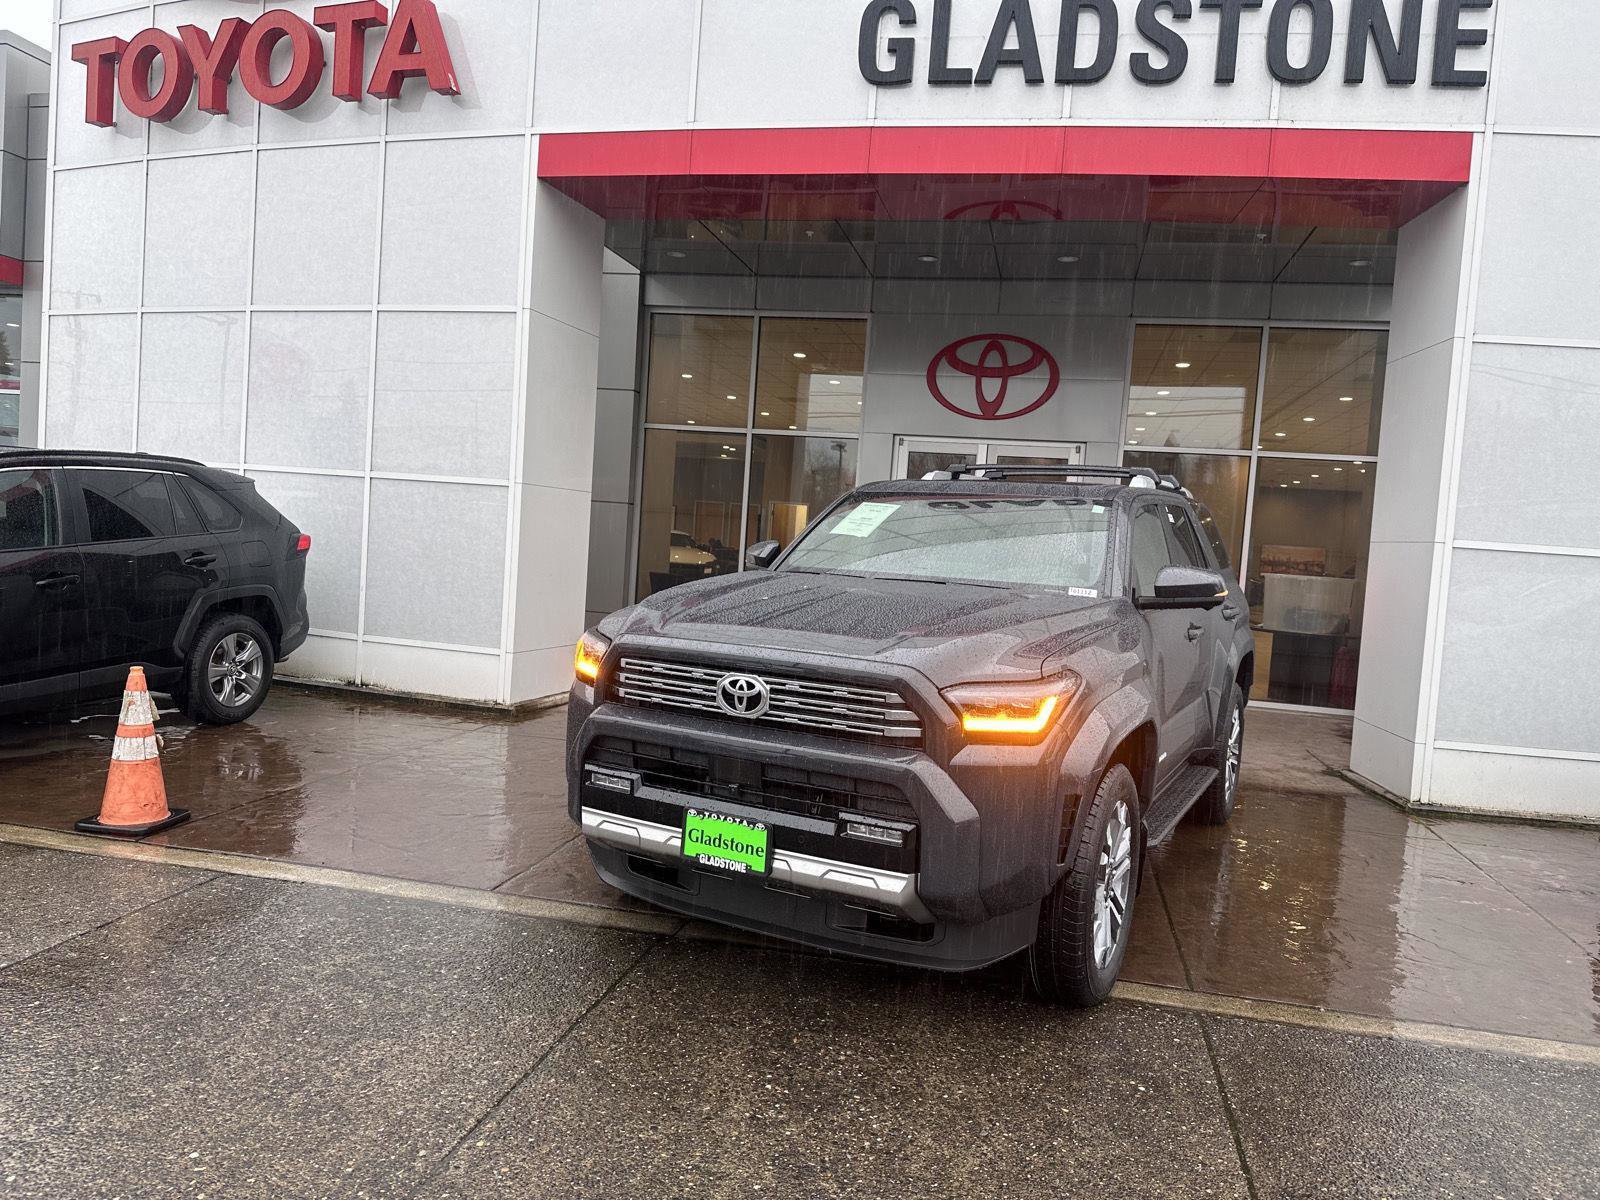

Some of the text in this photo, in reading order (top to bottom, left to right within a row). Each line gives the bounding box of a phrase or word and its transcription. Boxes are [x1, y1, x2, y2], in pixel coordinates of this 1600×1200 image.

[858, 0, 1493, 87] GLADSTONE
[72, 0, 461, 128] TOYOTA
[704, 812, 748, 827] TOYOTA
[688, 828, 764, 857] Gladstone
[700, 854, 747, 873] GLADSTONE
